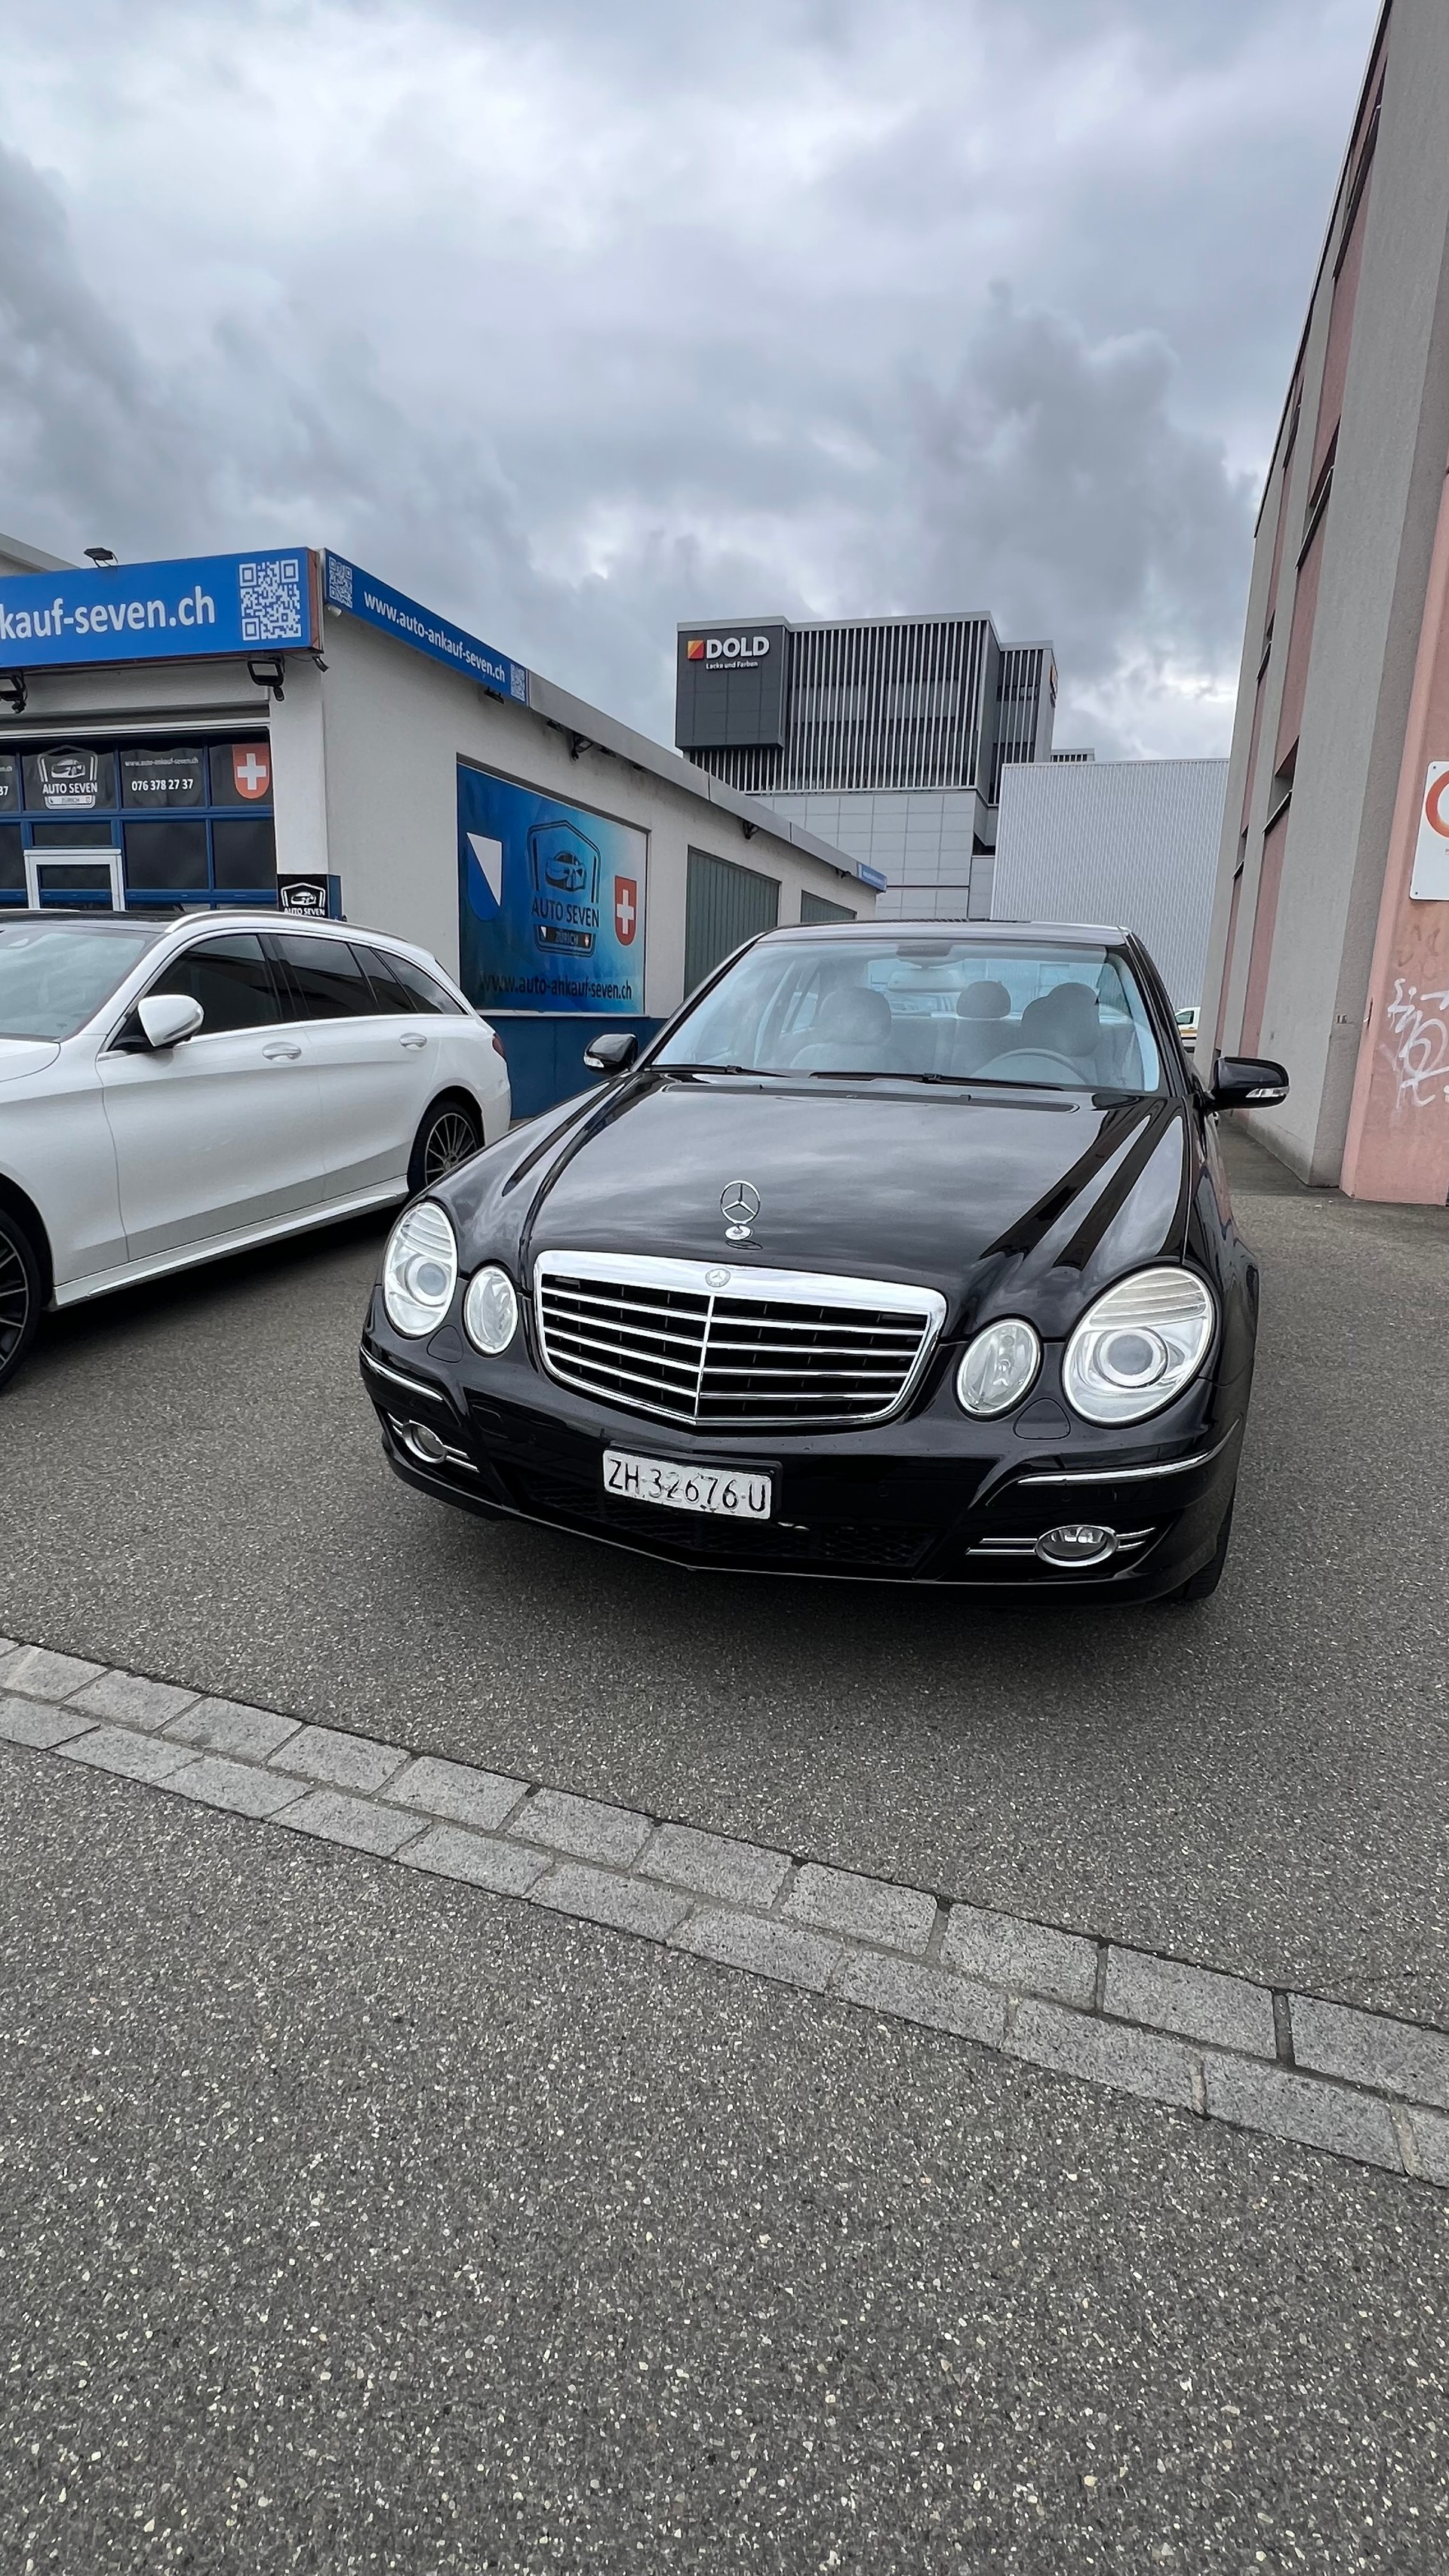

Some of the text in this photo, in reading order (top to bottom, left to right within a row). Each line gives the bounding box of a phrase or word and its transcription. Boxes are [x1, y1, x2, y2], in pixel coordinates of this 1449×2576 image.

[0, 585, 216, 640] kauf-seven.ch
[363, 591, 506, 683] www.auto-ankauf-seven.ch
[706, 636, 770, 659] DOLD
[737, 660, 758, 669] Farben
[42, 782, 98, 794] AUTO SEVEN
[131, 778, 194, 791] 076 378 27 37
[284, 907, 325, 916] AUTO SEVEN
[531, 897, 600, 928] AUTO SEVEN
[480, 974, 632, 1000] www.auto-ankauf-seven.ch
